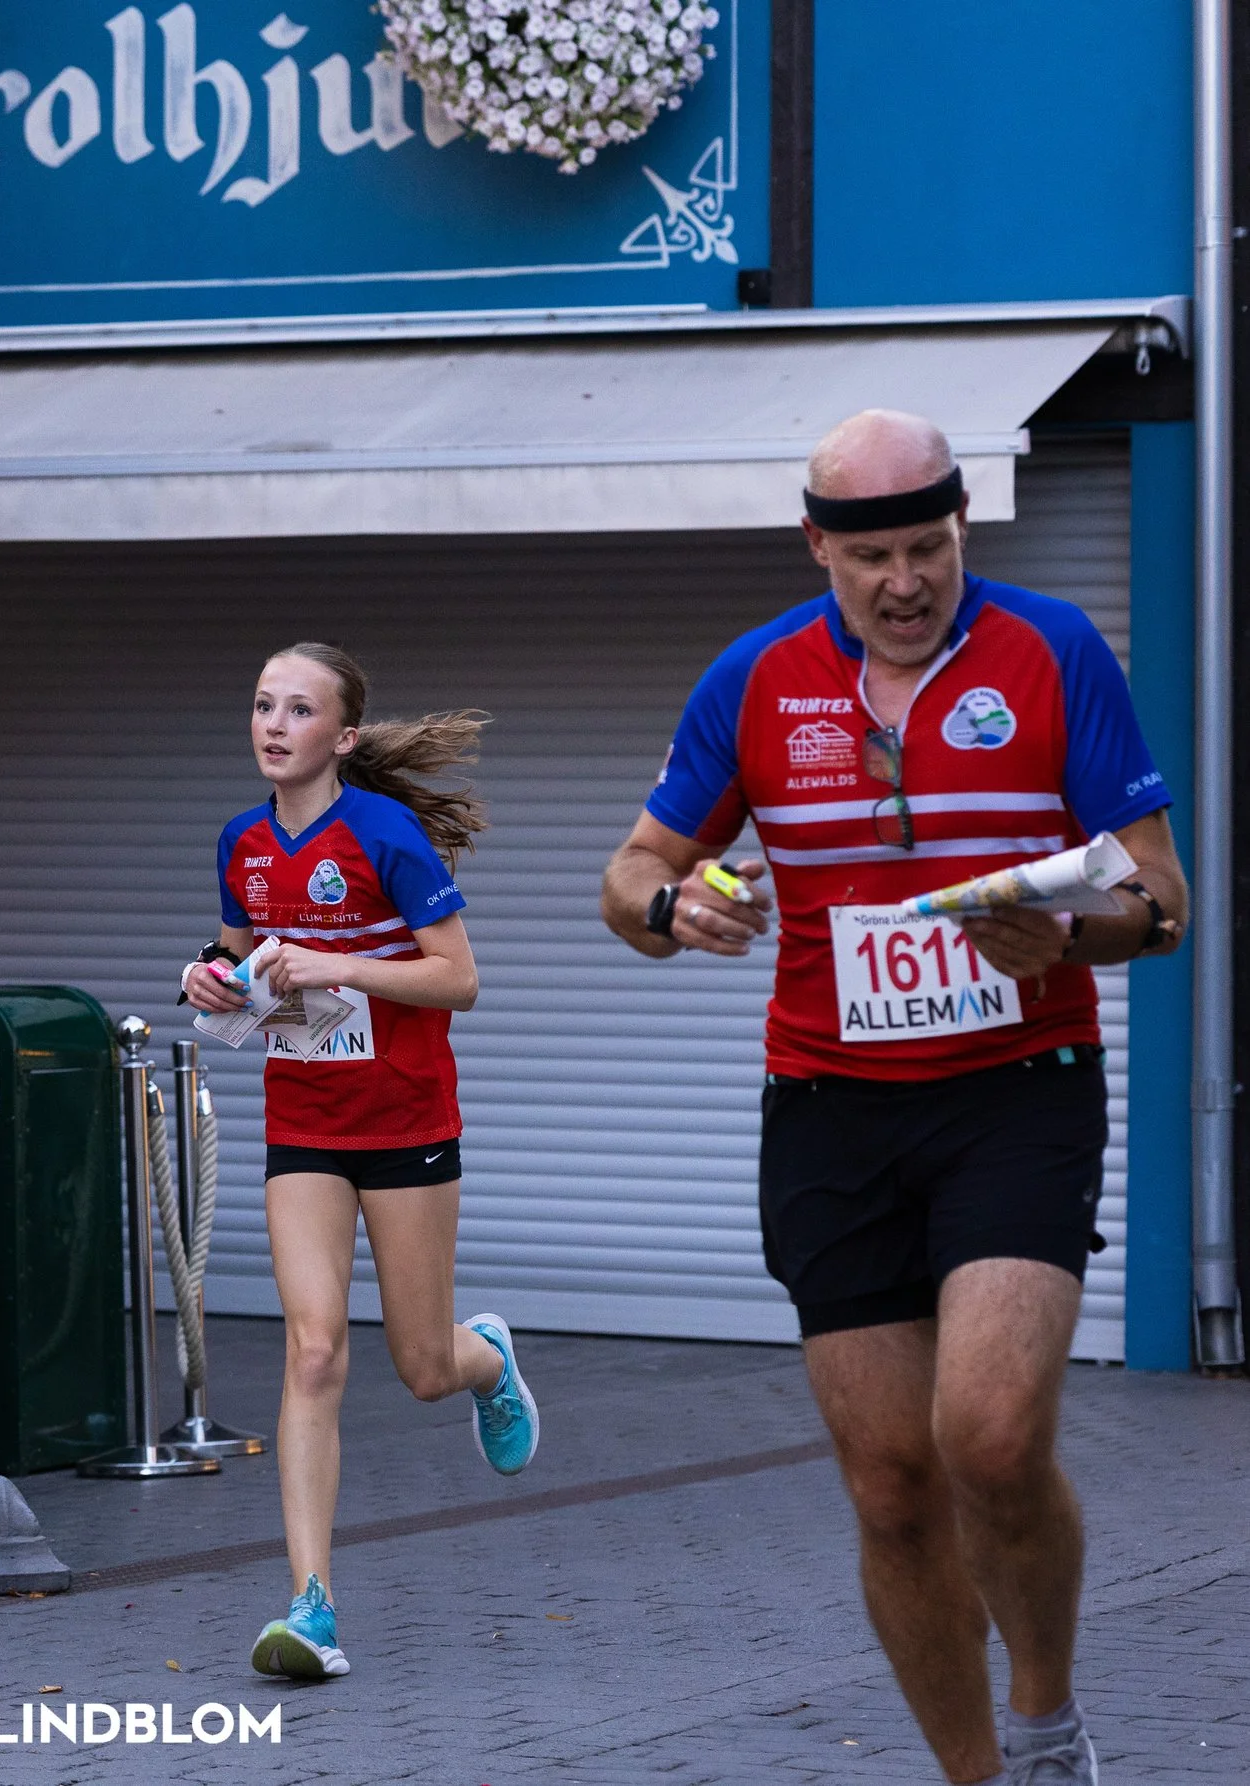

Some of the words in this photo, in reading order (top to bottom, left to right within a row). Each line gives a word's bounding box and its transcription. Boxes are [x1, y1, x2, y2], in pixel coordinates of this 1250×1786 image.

[777, 697, 854, 714] TRIMTEX
[786, 774, 857, 790] ALEWALDS
[244, 856, 274, 868] TRIMTEX
[427, 893, 440, 906] OK
[299, 912, 362, 923] LUMONITE
[856, 926, 981, 994] 1611
[846, 985, 1004, 1031] ALLEMAN
